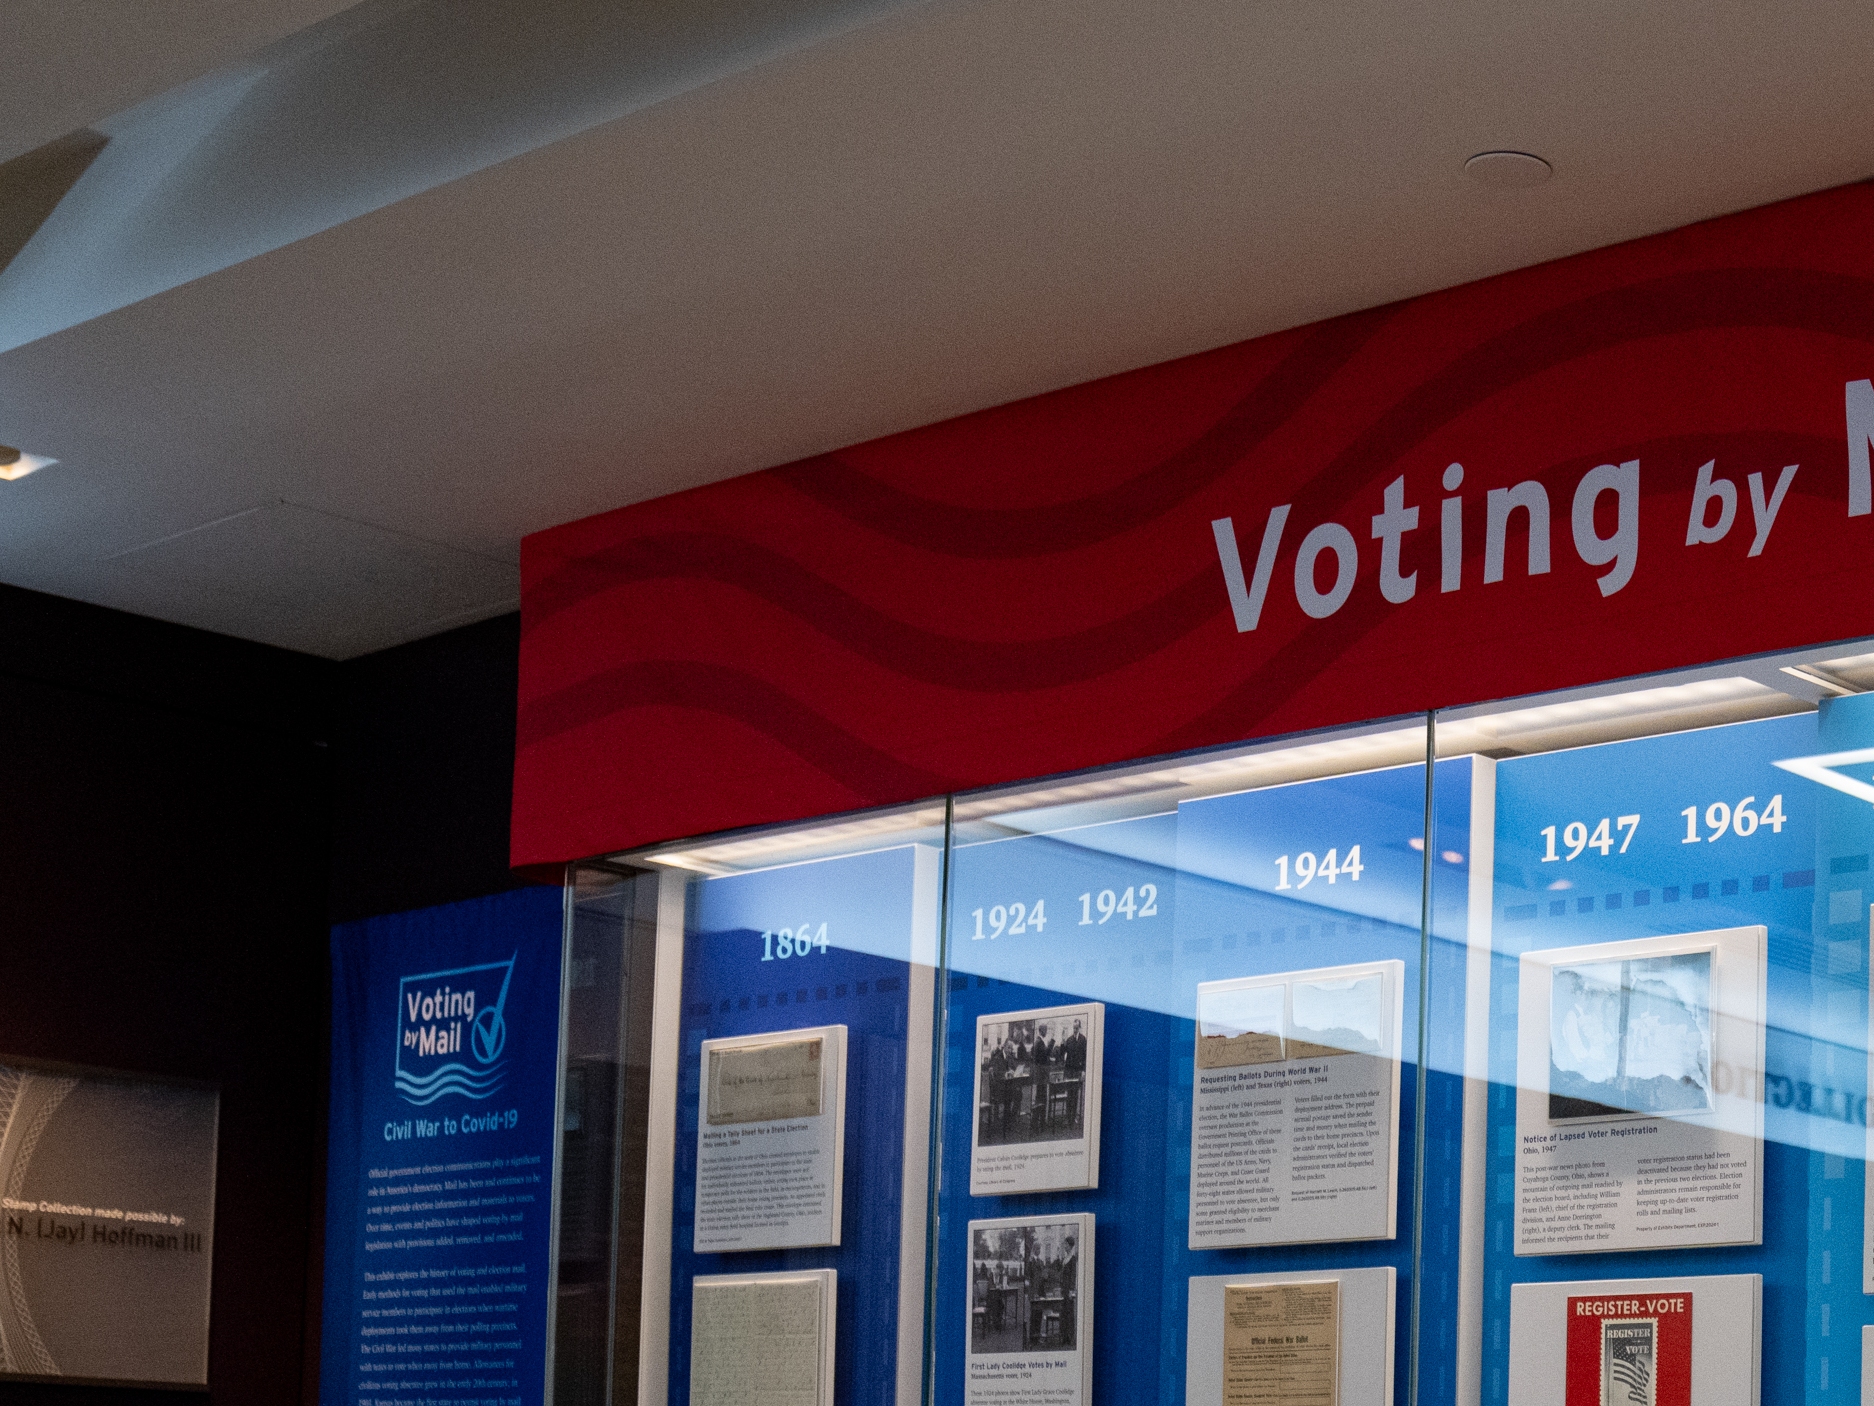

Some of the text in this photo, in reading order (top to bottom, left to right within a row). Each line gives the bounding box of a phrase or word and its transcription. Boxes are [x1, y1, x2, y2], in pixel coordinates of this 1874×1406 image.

[1211, 459, 1639, 632] Voting
[1685, 459, 1798, 557] by
[1540, 794, 1786, 862] 1947 1964
[1274, 845, 1364, 891] 1944
[971, 884, 1157, 940] 1924 1942
[761, 923, 830, 962] 1864
[408, 986, 474, 1022] Voting
[404, 1022, 461, 1057] by Mail
[1201, 1073, 1236, 1084] Requesting
[1239, 1071, 1262, 1080] Ballots
[1264, 1069, 1286, 1080] During
[1288, 1068, 1307, 1076] World
[1309, 1066, 1321, 1074] War
[384, 1110, 518, 1141] Civil War to Covid-19
[1523, 1125, 1658, 1144] Notice of Lapsed Voter Registration
[39, 1201, 92, 1215] Collection
[95, 1208, 123, 1219] made
[125, 1211, 167, 1223] possible
[93, 1224, 178, 1249] Hoffman
[1577, 1299, 1684, 1316] REGISTER-VOTE
[1607, 1329, 1651, 1338] REGISTER
[1625, 1346, 1649, 1354] VOTE
[1002, 1362, 1026, 1370] Coolidge
[1046, 1361, 1052, 1369] by
